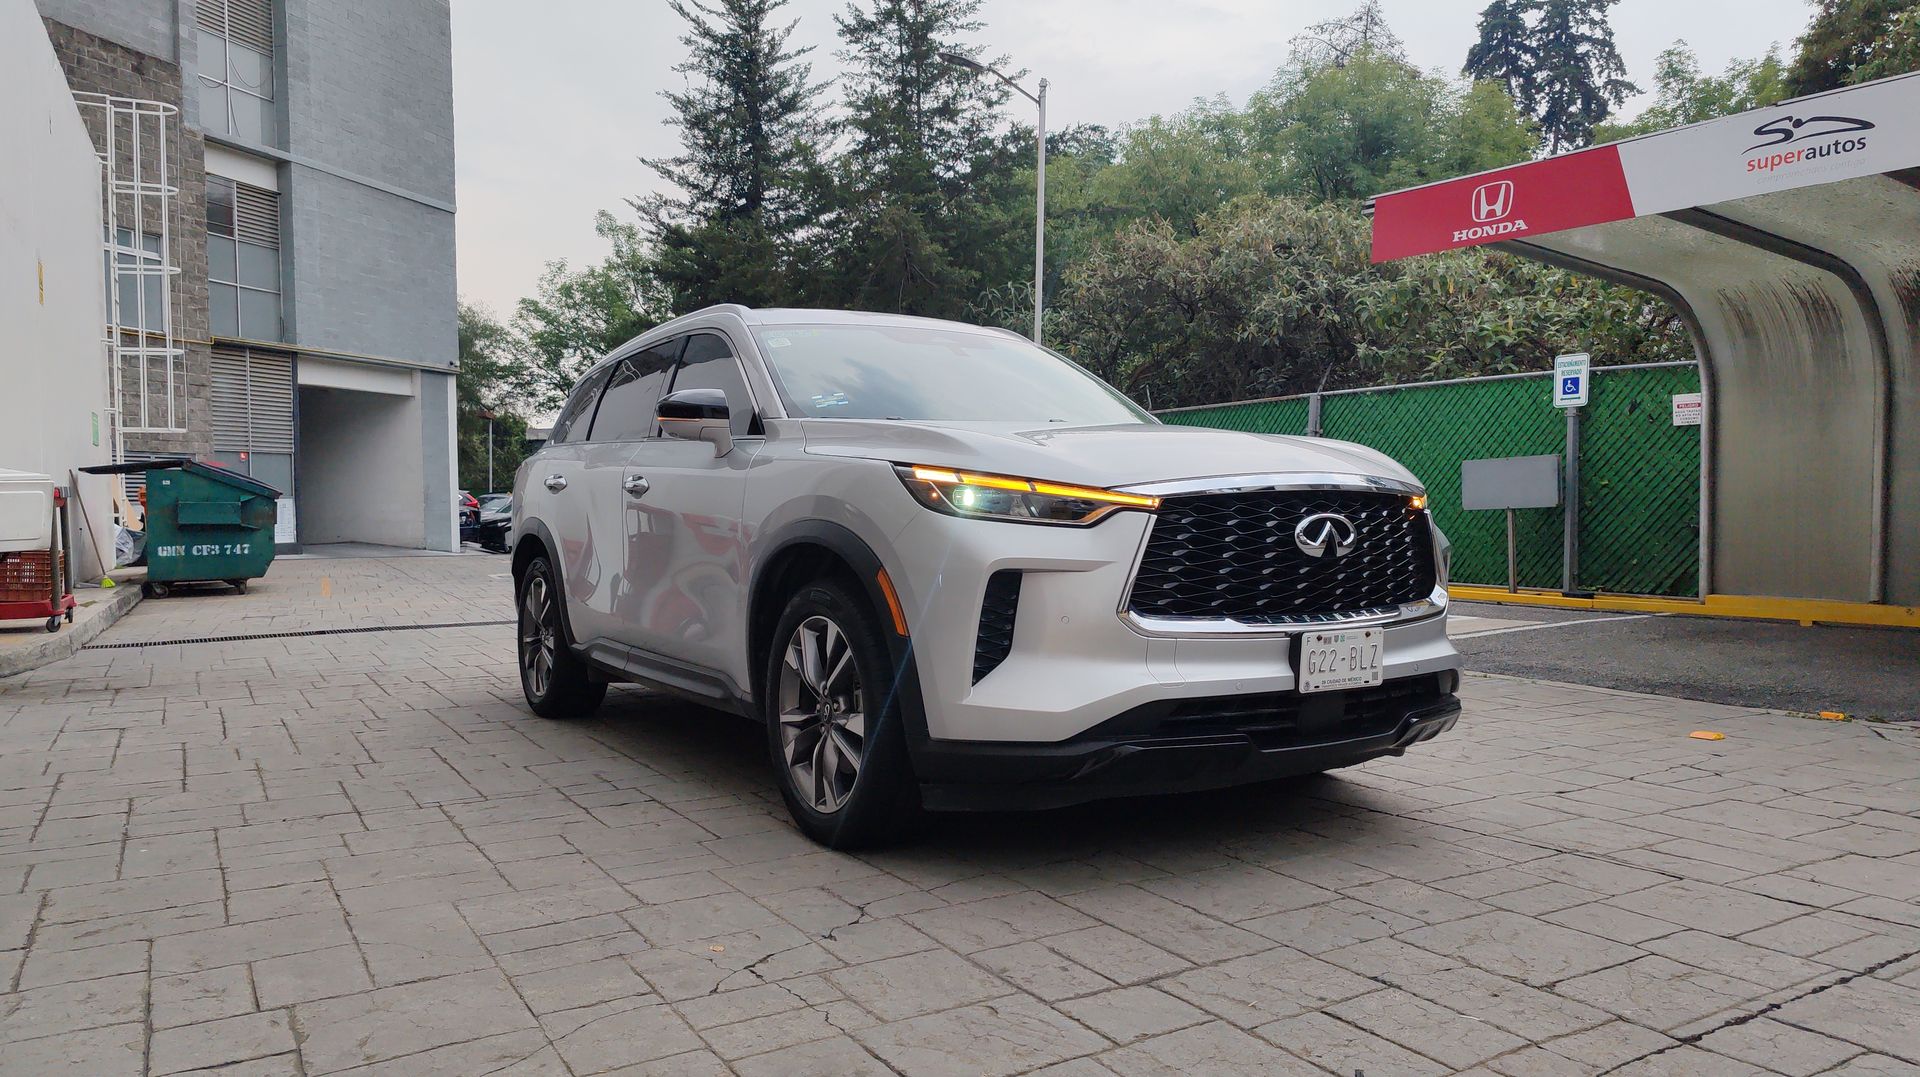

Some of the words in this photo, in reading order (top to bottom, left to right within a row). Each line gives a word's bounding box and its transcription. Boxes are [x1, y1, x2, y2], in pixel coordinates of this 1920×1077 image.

[1747, 136, 1867, 172] superautos
[1452, 219, 1529, 243] HONDA
[224, 543, 251, 555] 747
[1308, 643, 1378, 676] G22-BLZ
